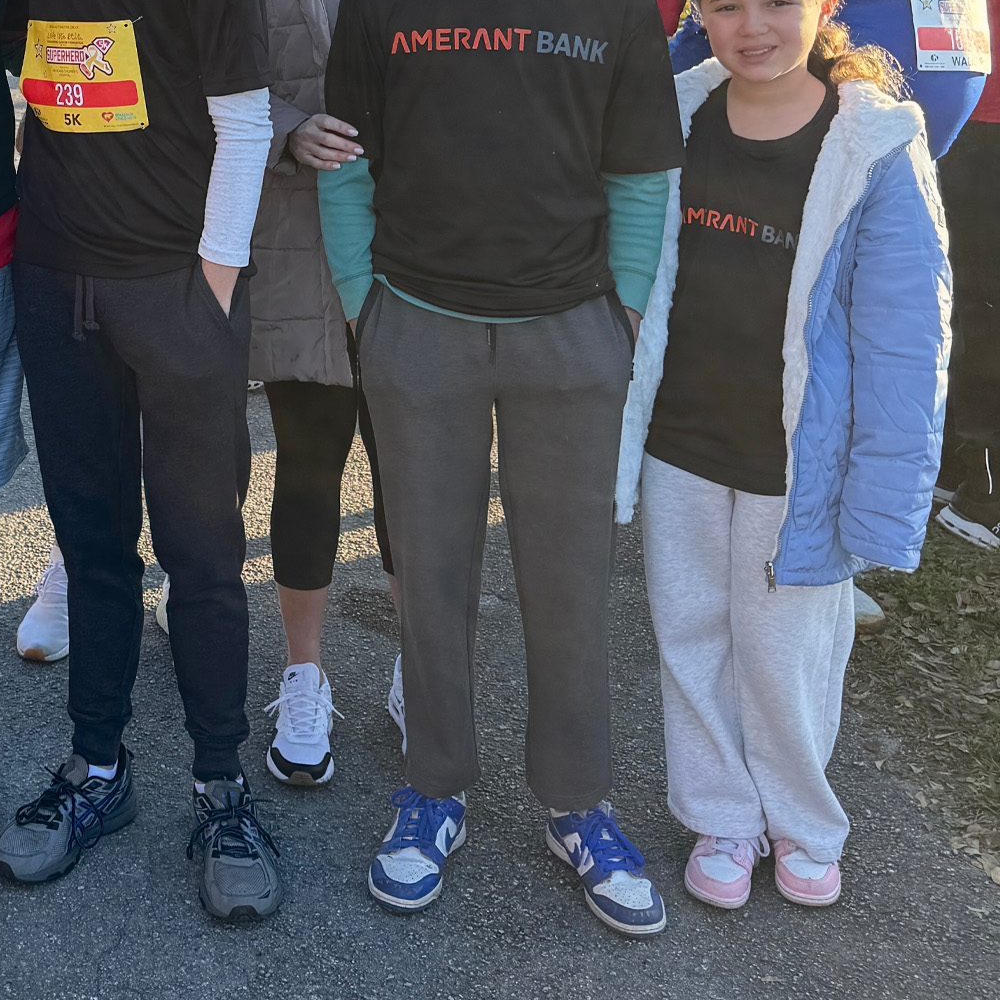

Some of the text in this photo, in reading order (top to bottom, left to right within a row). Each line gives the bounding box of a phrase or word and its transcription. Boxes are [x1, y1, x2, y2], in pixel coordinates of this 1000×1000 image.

[47, 49, 84, 62] SUPERHERO
[392, 28, 608, 64] AMERANT BANK
[55, 83, 84, 106] 239
[64, 113, 82, 126] 5K
[761, 224, 800, 250] BAN
